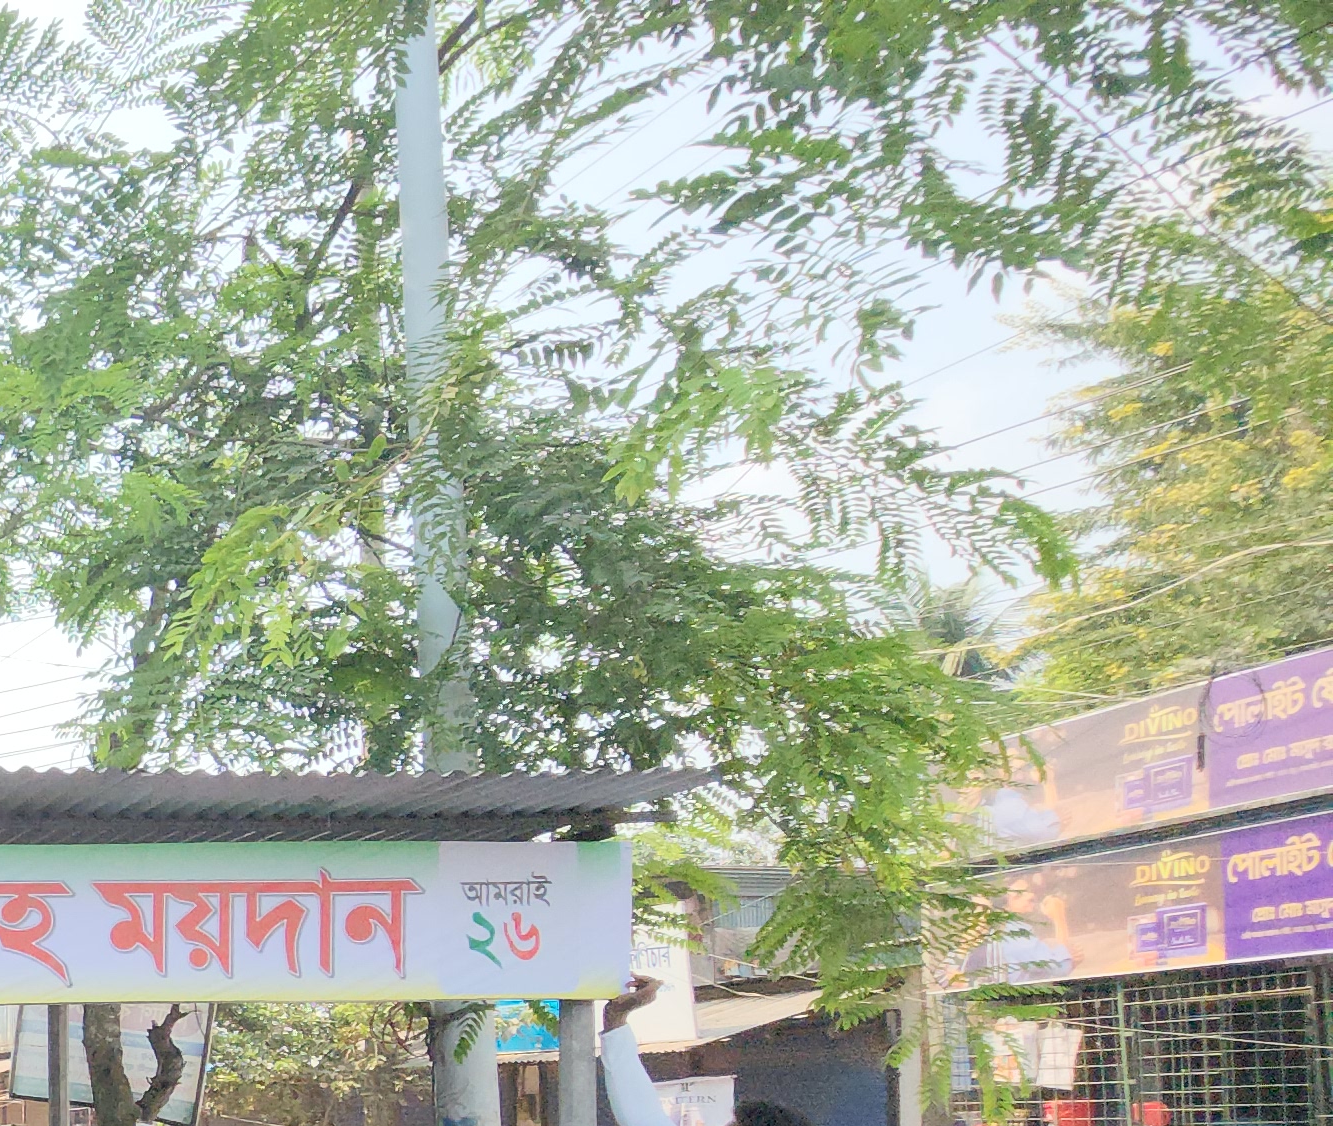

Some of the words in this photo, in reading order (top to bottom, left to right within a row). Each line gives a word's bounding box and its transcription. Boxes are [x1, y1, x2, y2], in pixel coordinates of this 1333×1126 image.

[1123, 705, 1199, 739] DIVINO
[1213, 676, 1307, 733] পোলাইট
[1135, 854, 1211, 882] DIVINO
[1227, 832, 1322, 883] পোলাইট
[459, 871, 552, 907] আমরাই
[89, 876, 426, 981] ময়দান
[465, 911, 542, 969] ২৬
